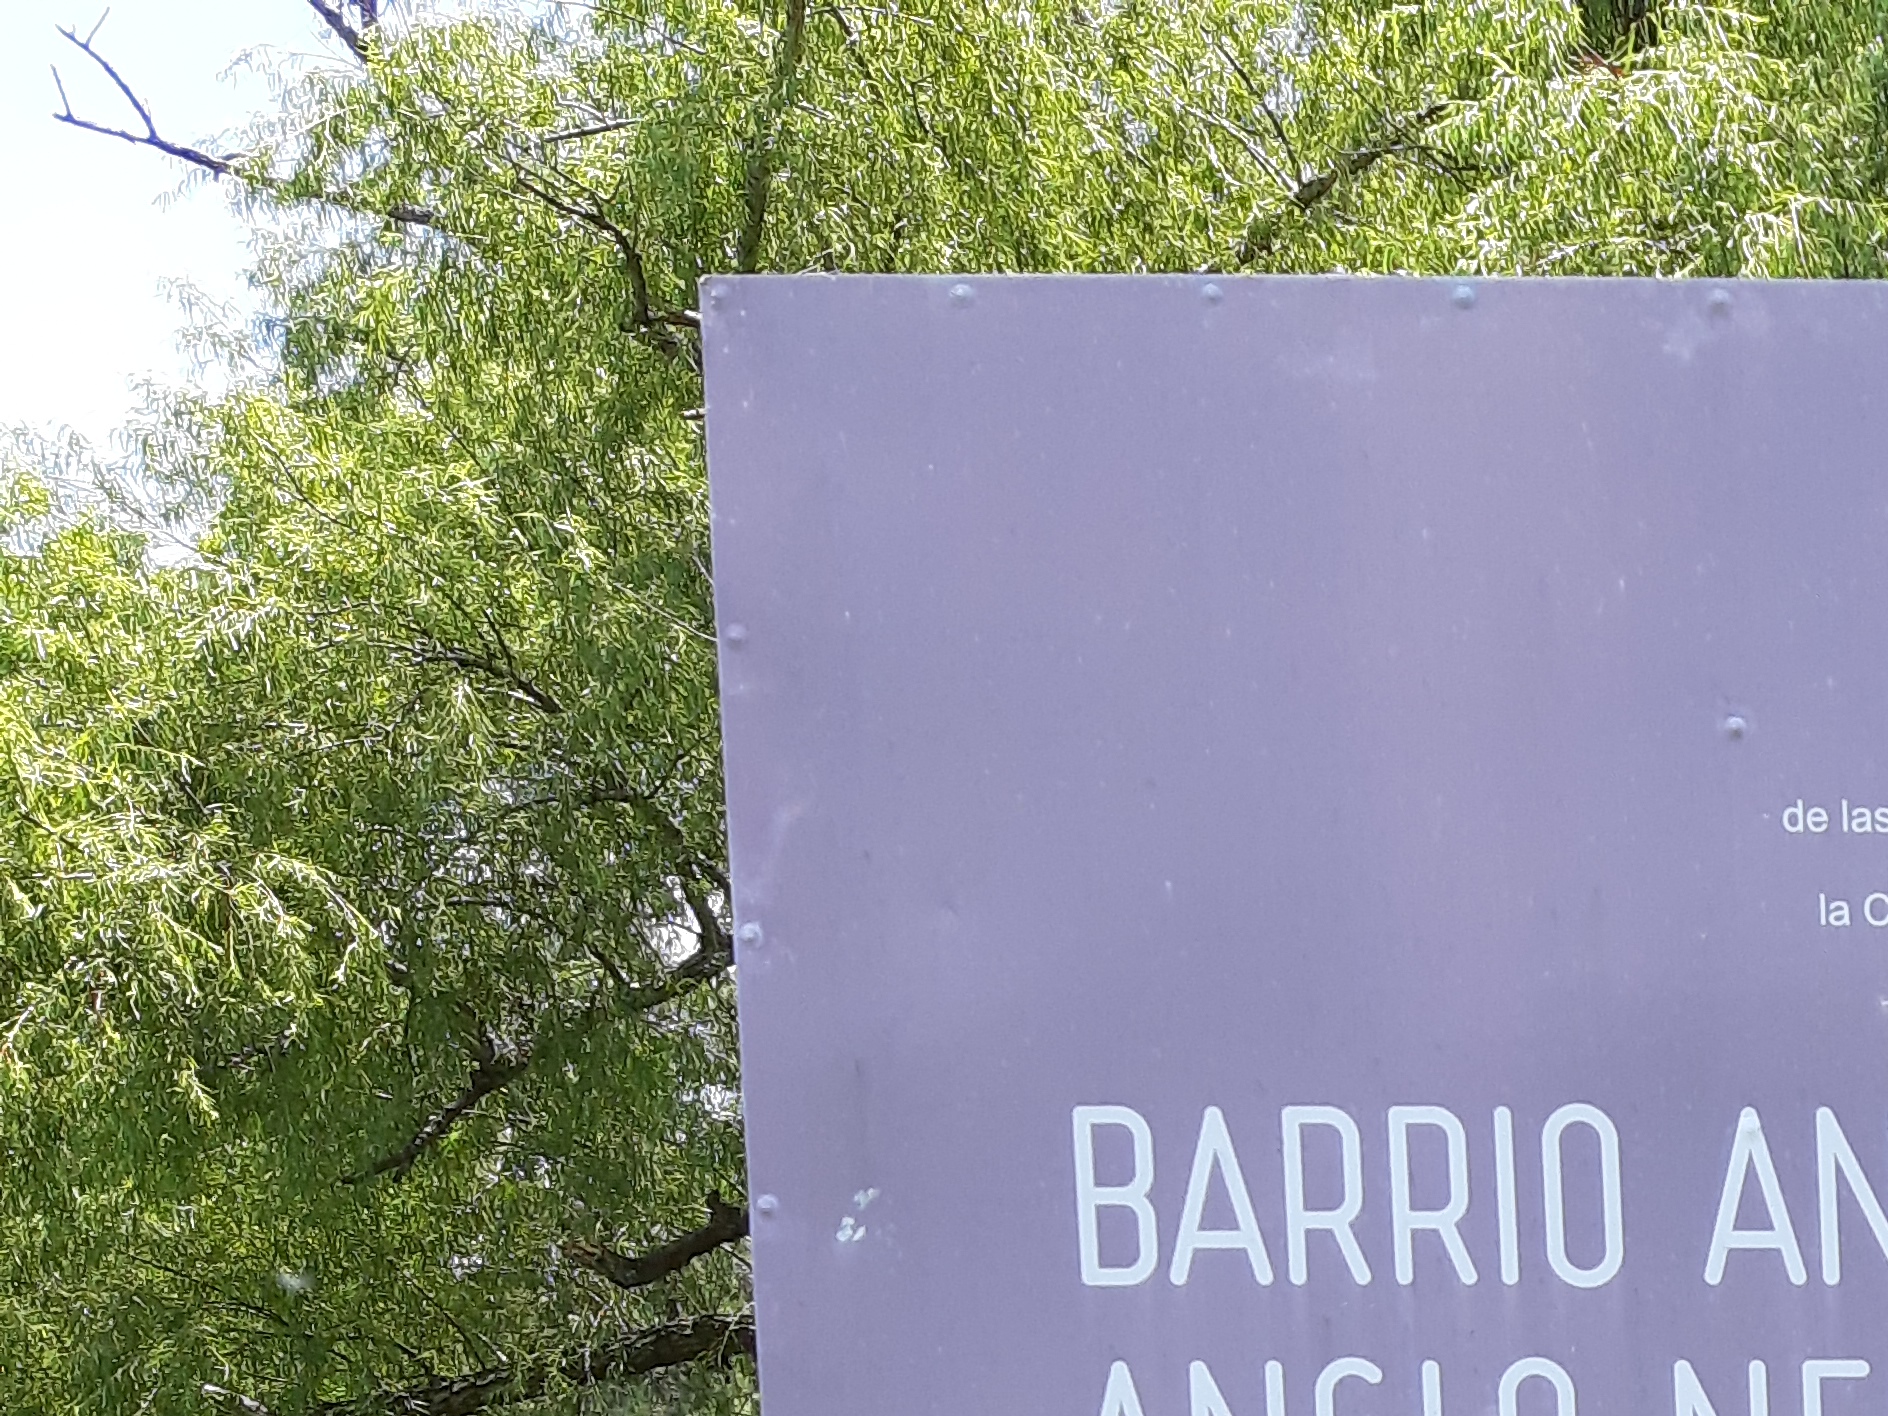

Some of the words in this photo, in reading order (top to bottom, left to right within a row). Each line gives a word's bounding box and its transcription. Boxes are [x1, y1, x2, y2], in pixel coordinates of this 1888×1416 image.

[1782, 799, 1830, 834] de
[1818, 892, 1851, 928] la
[1070, 1102, 1625, 1289] BARRIO
